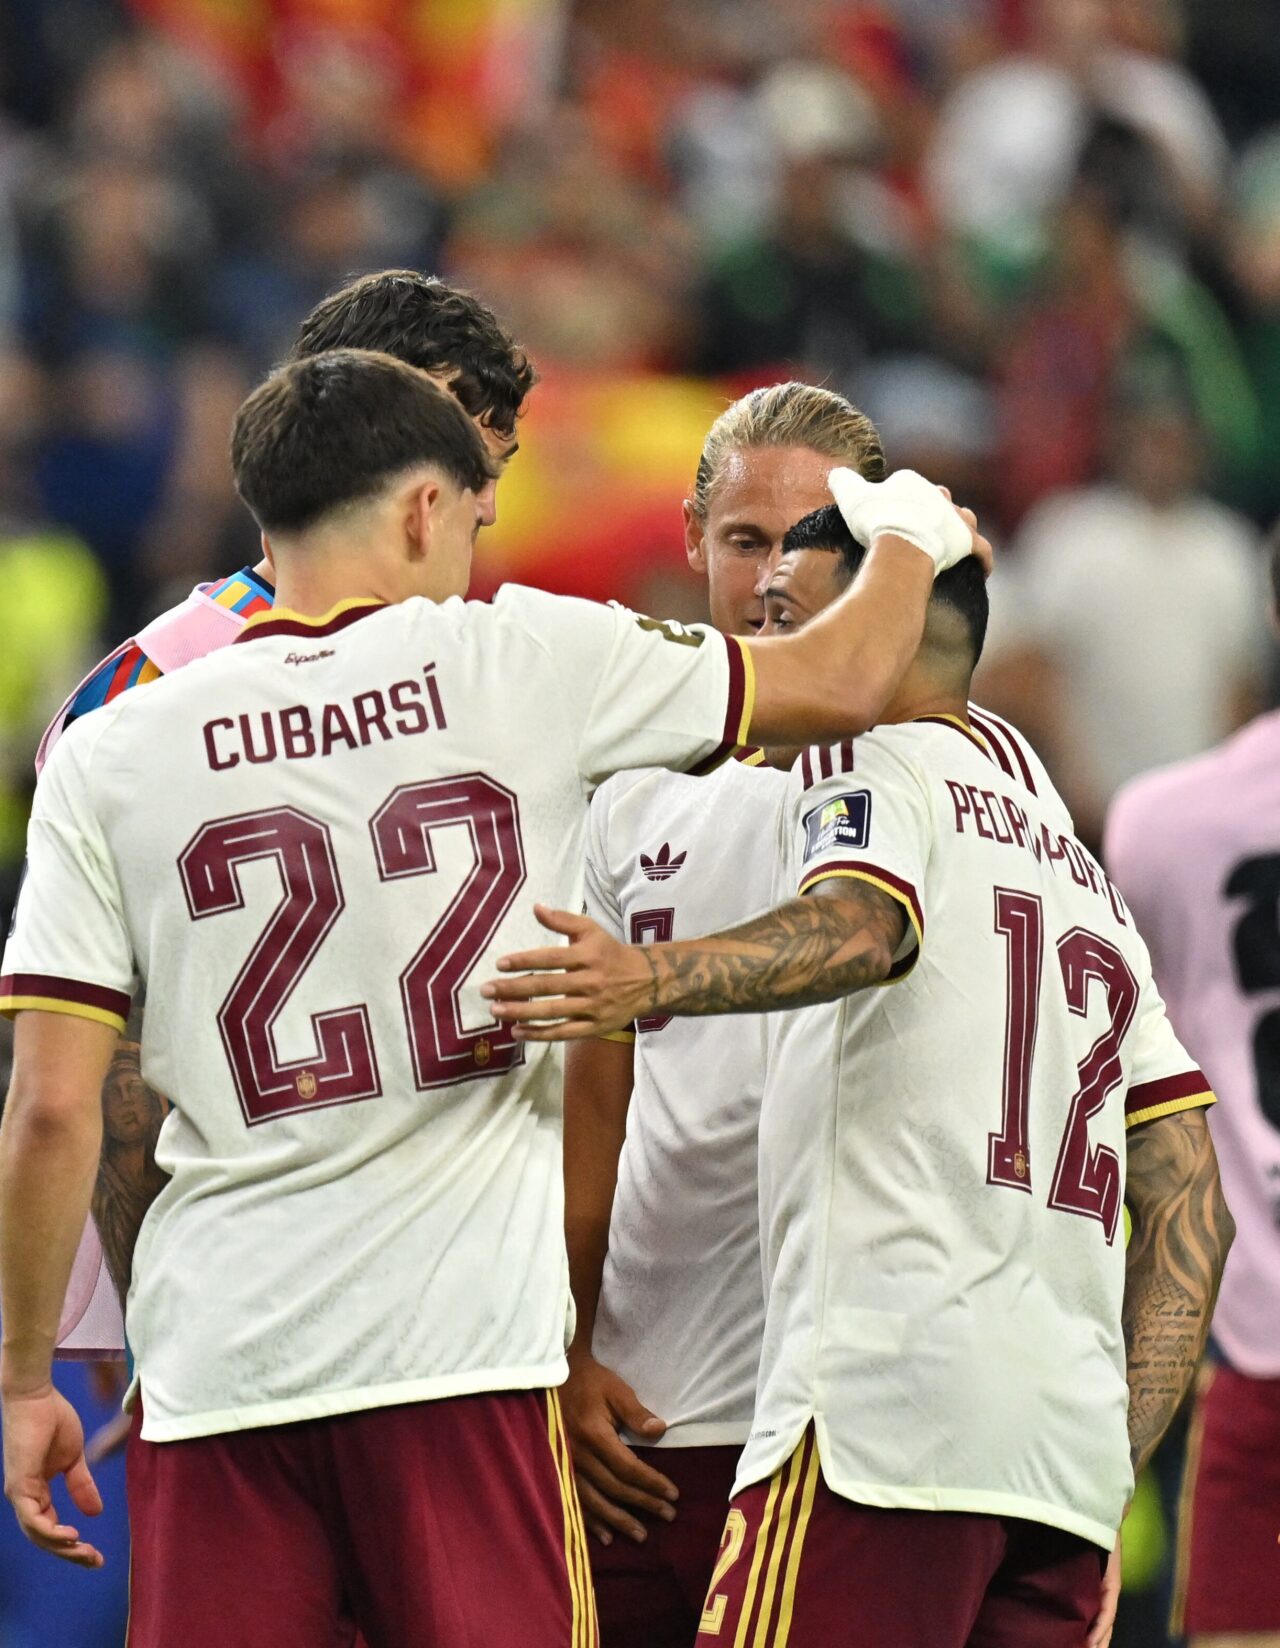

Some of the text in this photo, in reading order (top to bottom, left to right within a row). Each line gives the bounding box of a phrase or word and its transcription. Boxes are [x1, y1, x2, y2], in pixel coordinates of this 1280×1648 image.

[203, 661, 448, 771] CUBARSÍ
[176, 771, 527, 1128] 22
[986, 885, 1140, 1247] 12
